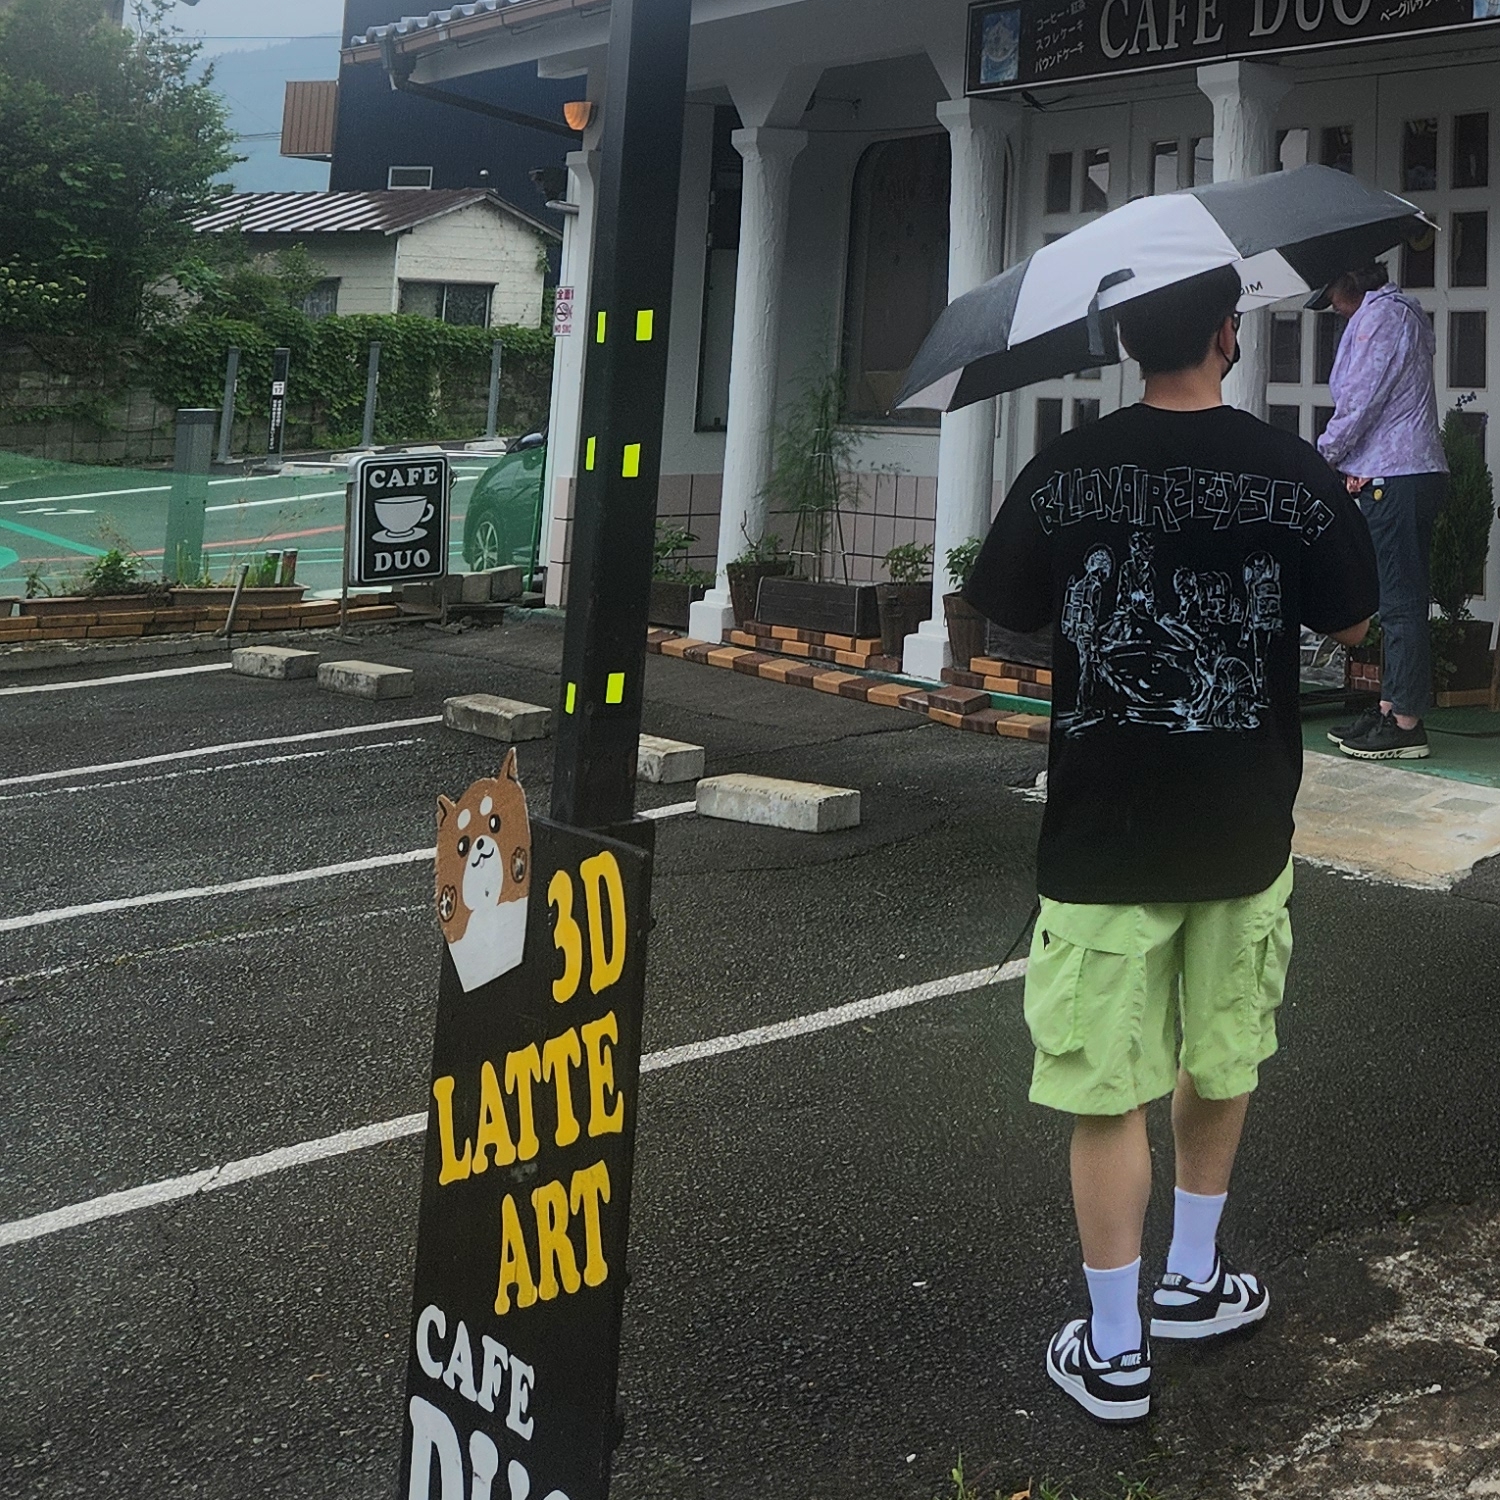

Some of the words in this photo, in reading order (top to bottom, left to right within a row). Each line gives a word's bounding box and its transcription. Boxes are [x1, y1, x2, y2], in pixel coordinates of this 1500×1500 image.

[1036, 20, 1084, 51] スフレケーキ
[1035, 42, 1085, 73] パウンドケーキ
[369, 466, 439, 489] CAFE
[374, 549, 431, 572] DUO
[547, 851, 627, 1003] 3D
[433, 1010, 625, 1186] LATTE
[494, 1160, 611, 1315] ART
[1161, 1273, 1182, 1286] NIKE
[416, 1304, 535, 1441] CAFE
[1120, 1352, 1142, 1367] NIKE
